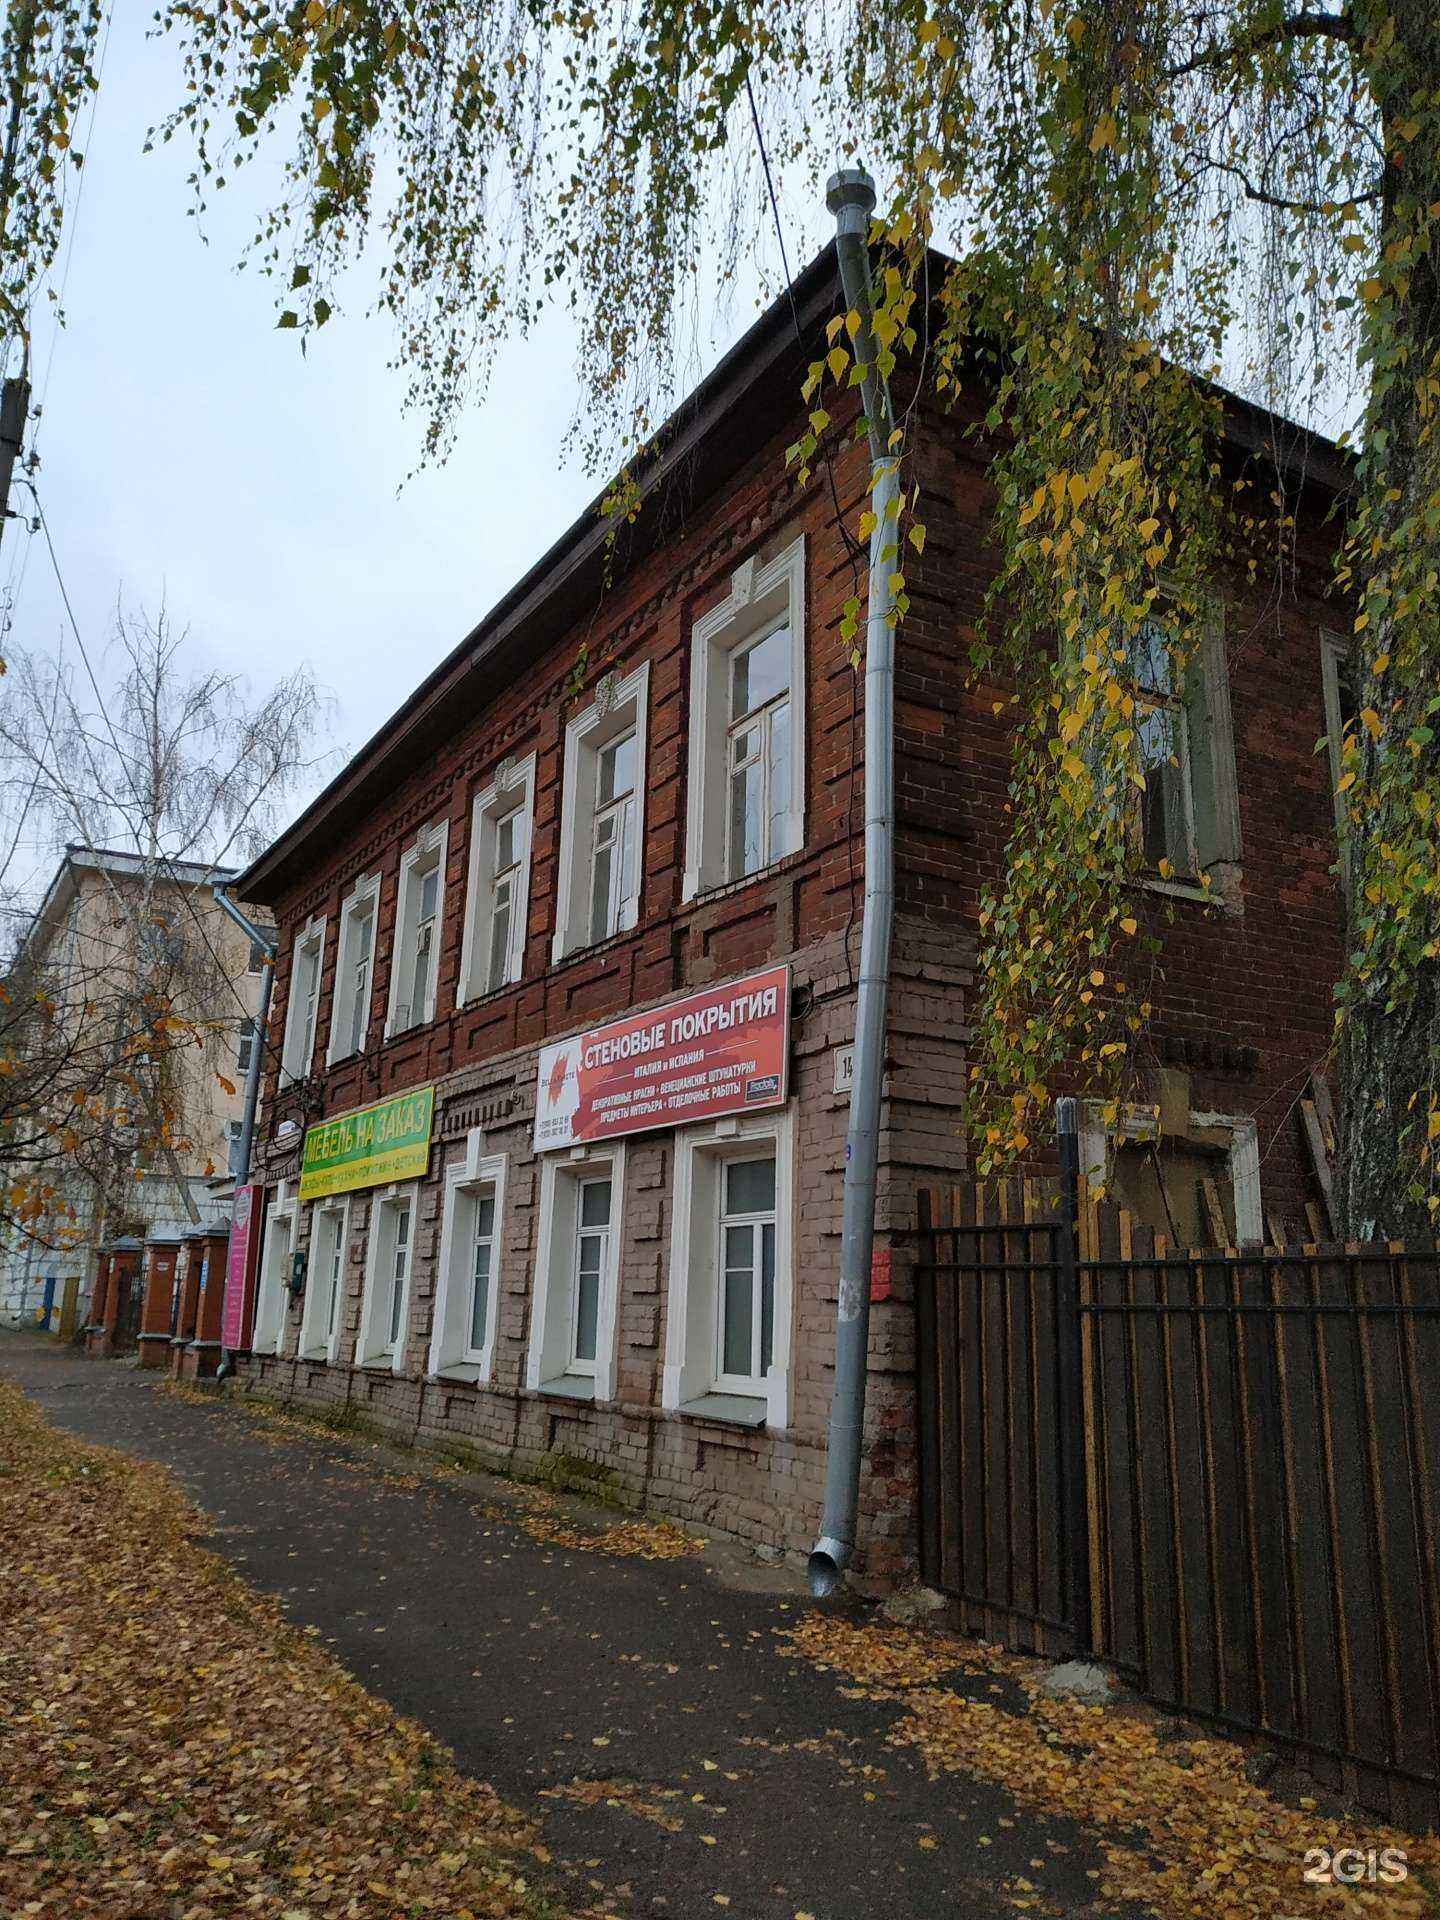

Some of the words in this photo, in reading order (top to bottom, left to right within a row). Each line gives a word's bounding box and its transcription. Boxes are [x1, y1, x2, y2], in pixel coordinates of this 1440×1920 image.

[584, 1023, 666, 1069] СТЕНОВЫЕ
[671, 987, 778, 1043] ПОКРЫТИЯ
[634, 1060, 662, 1078] ИТАЛИЯ
[669, 1049, 705, 1069] ИСПАНИЯ
[708, 1060, 756, 1082] ШТУКАТУРКИ
[630, 1099, 663, 1117] ИНТЕРЬЕРА
[667, 1088, 710, 1109] ОТДЕЛОЧНЫЕ
[711, 1081, 741, 1099] РАБОТЫ
[306, 1124, 353, 1163] МЕБЕЛЬ
[355, 1117, 376, 1149] НА
[376, 1101, 426, 1144] ЗАКАЗ
